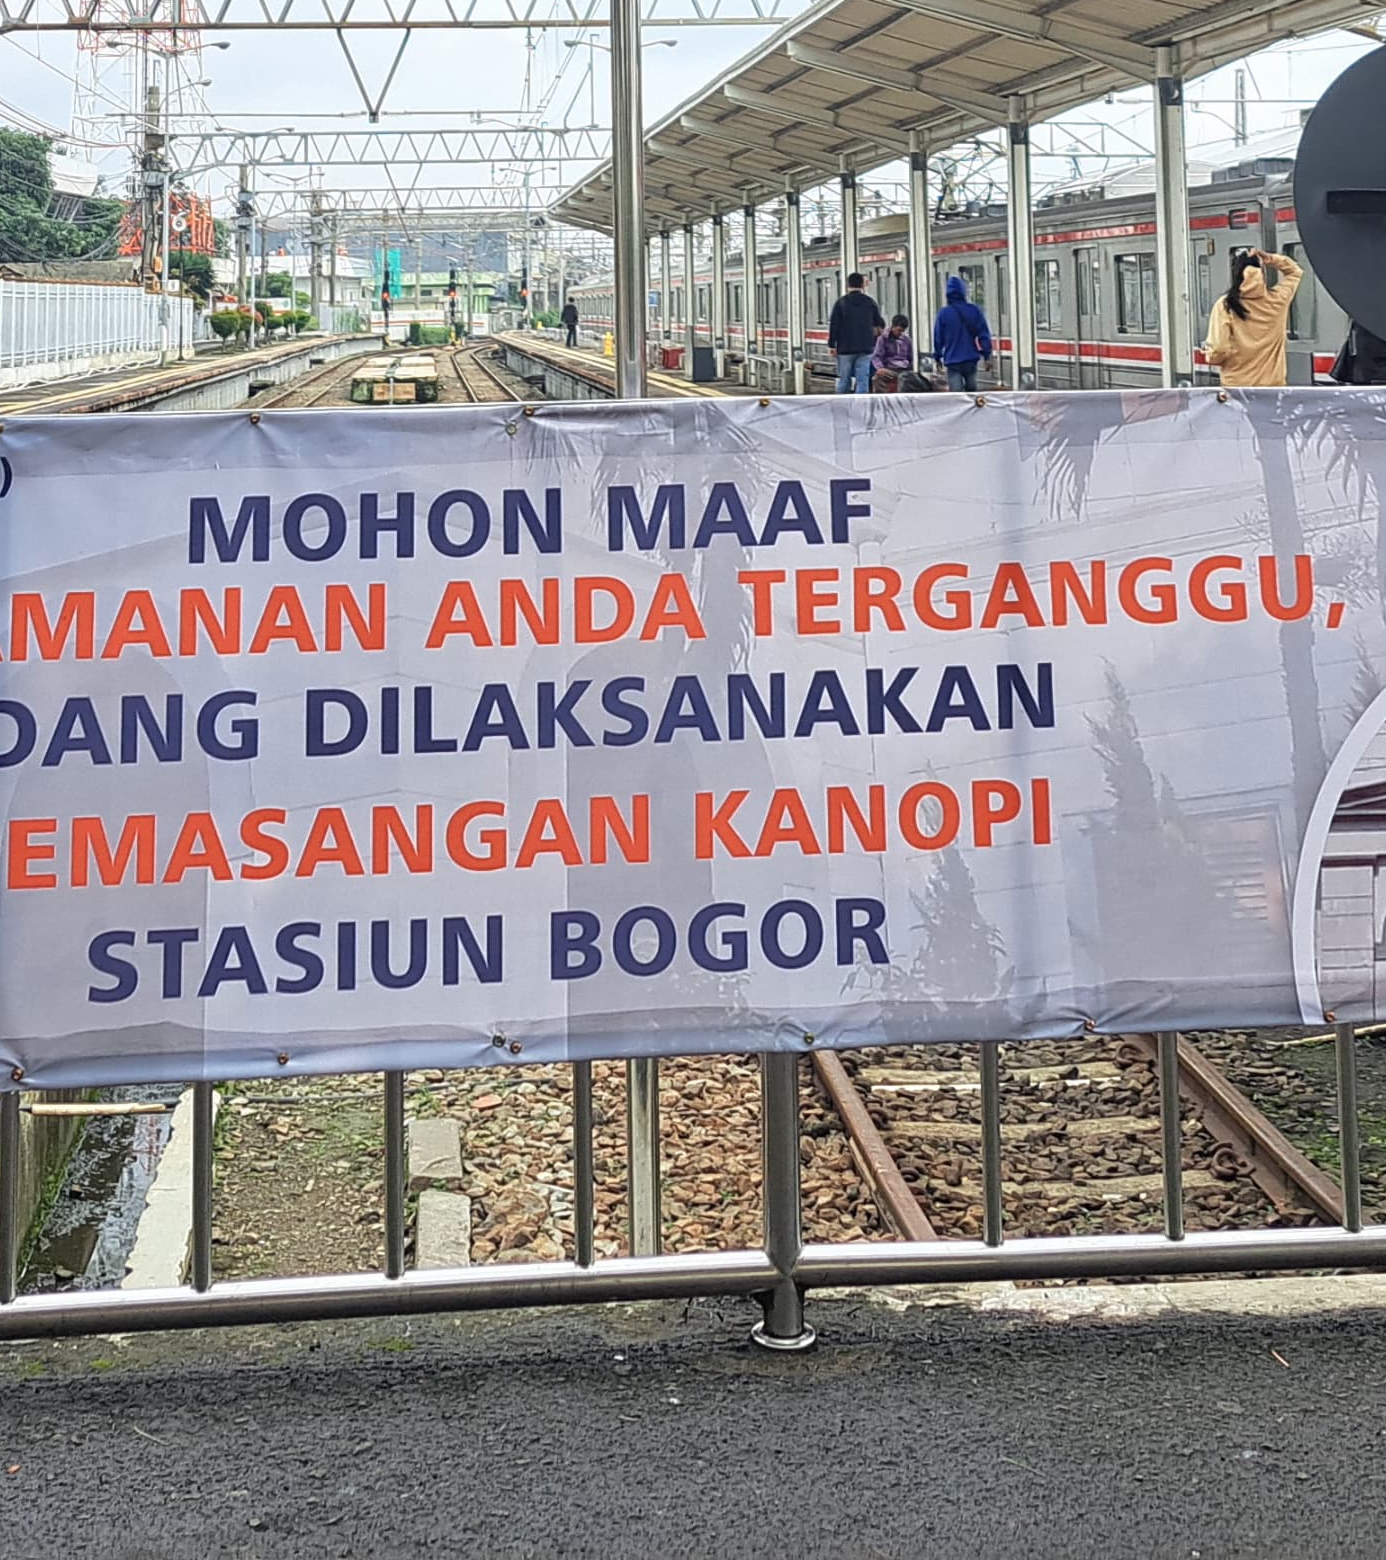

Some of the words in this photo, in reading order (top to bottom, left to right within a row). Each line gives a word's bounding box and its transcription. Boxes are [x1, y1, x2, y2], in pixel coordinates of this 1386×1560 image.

[188, 487, 563, 565] MOHON
[607, 478, 873, 552] MAAF
[424, 572, 707, 650] ANDA
[737, 554, 1345, 637] TERGANGGU,
[305, 662, 1056, 758] DILAKSANAKAN
[694, 777, 1052, 861] KANOPI
[87, 915, 504, 1004] STASIUN
[549, 897, 892, 981] BOGOR
